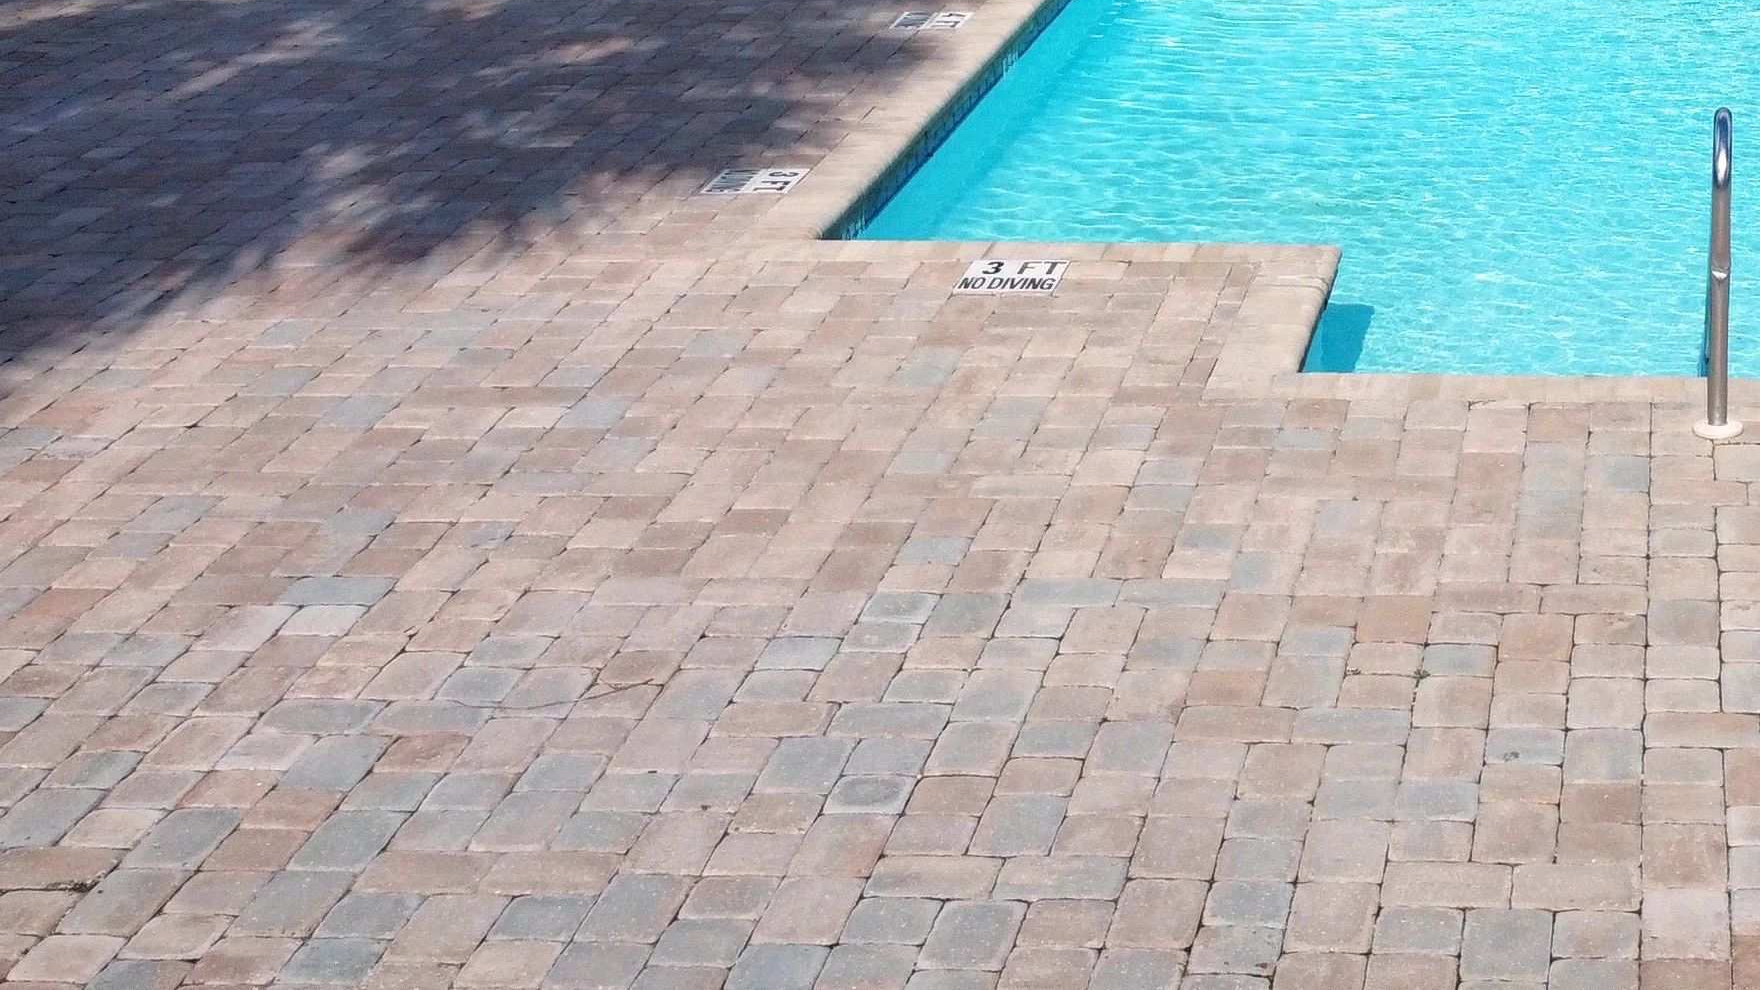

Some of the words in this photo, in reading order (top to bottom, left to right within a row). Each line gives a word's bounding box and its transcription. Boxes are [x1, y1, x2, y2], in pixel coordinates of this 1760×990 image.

[982, 261, 1005, 274] 3
[1016, 261, 1067, 275] FT
[957, 277, 986, 290] NO
[987, 277, 1056, 290] DIVING
